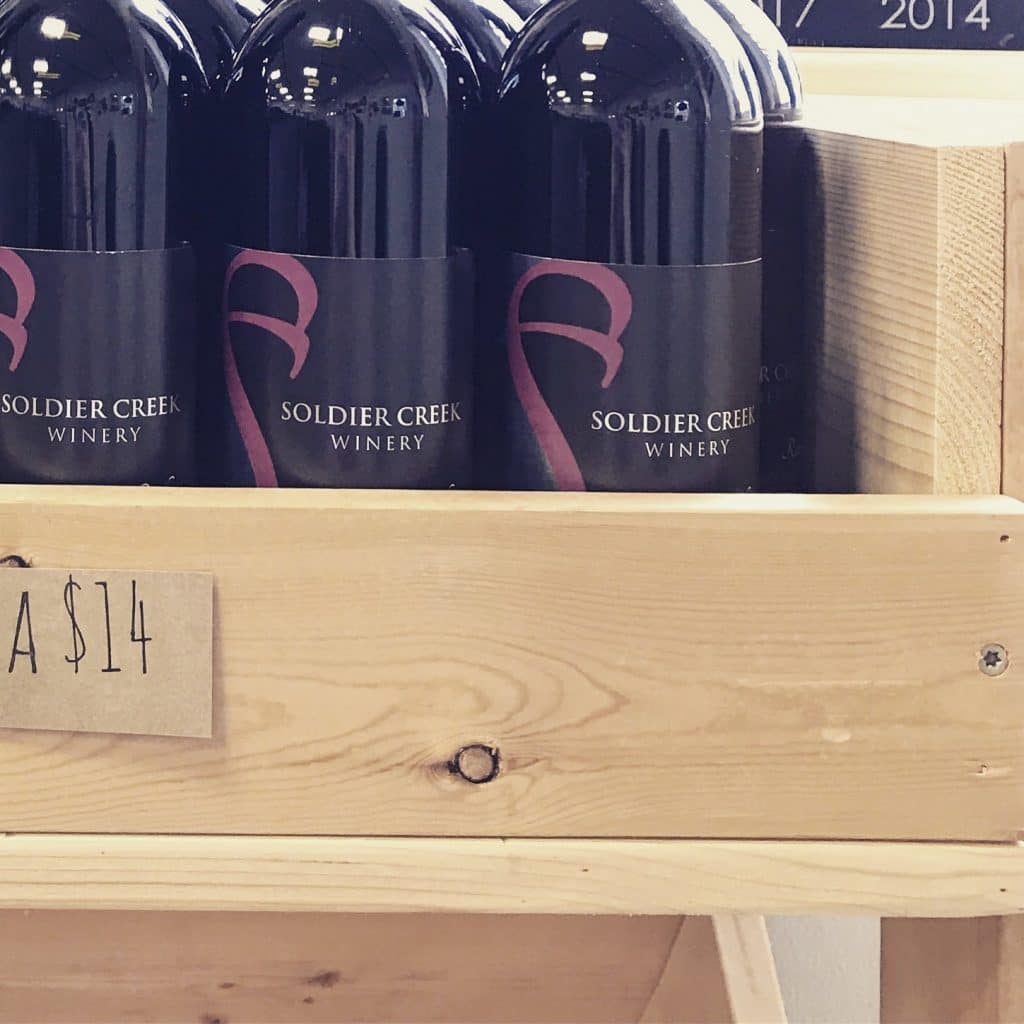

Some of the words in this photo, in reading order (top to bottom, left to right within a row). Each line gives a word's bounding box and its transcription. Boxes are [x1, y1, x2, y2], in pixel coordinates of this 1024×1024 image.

[1, 394, 107, 419] SOLDIER
[112, 395, 181, 419] CREEK
[281, 401, 392, 427] SOLDIER
[396, 402, 462, 427] CREEK
[591, 410, 703, 434] SOLDIER
[707, 406, 756, 432] CREEK
[48, 426, 141, 444] WINERY
[330, 434, 425, 452] WINERY
[644, 439, 730, 458] WINERY
[63, 574, 153, 675] $14
